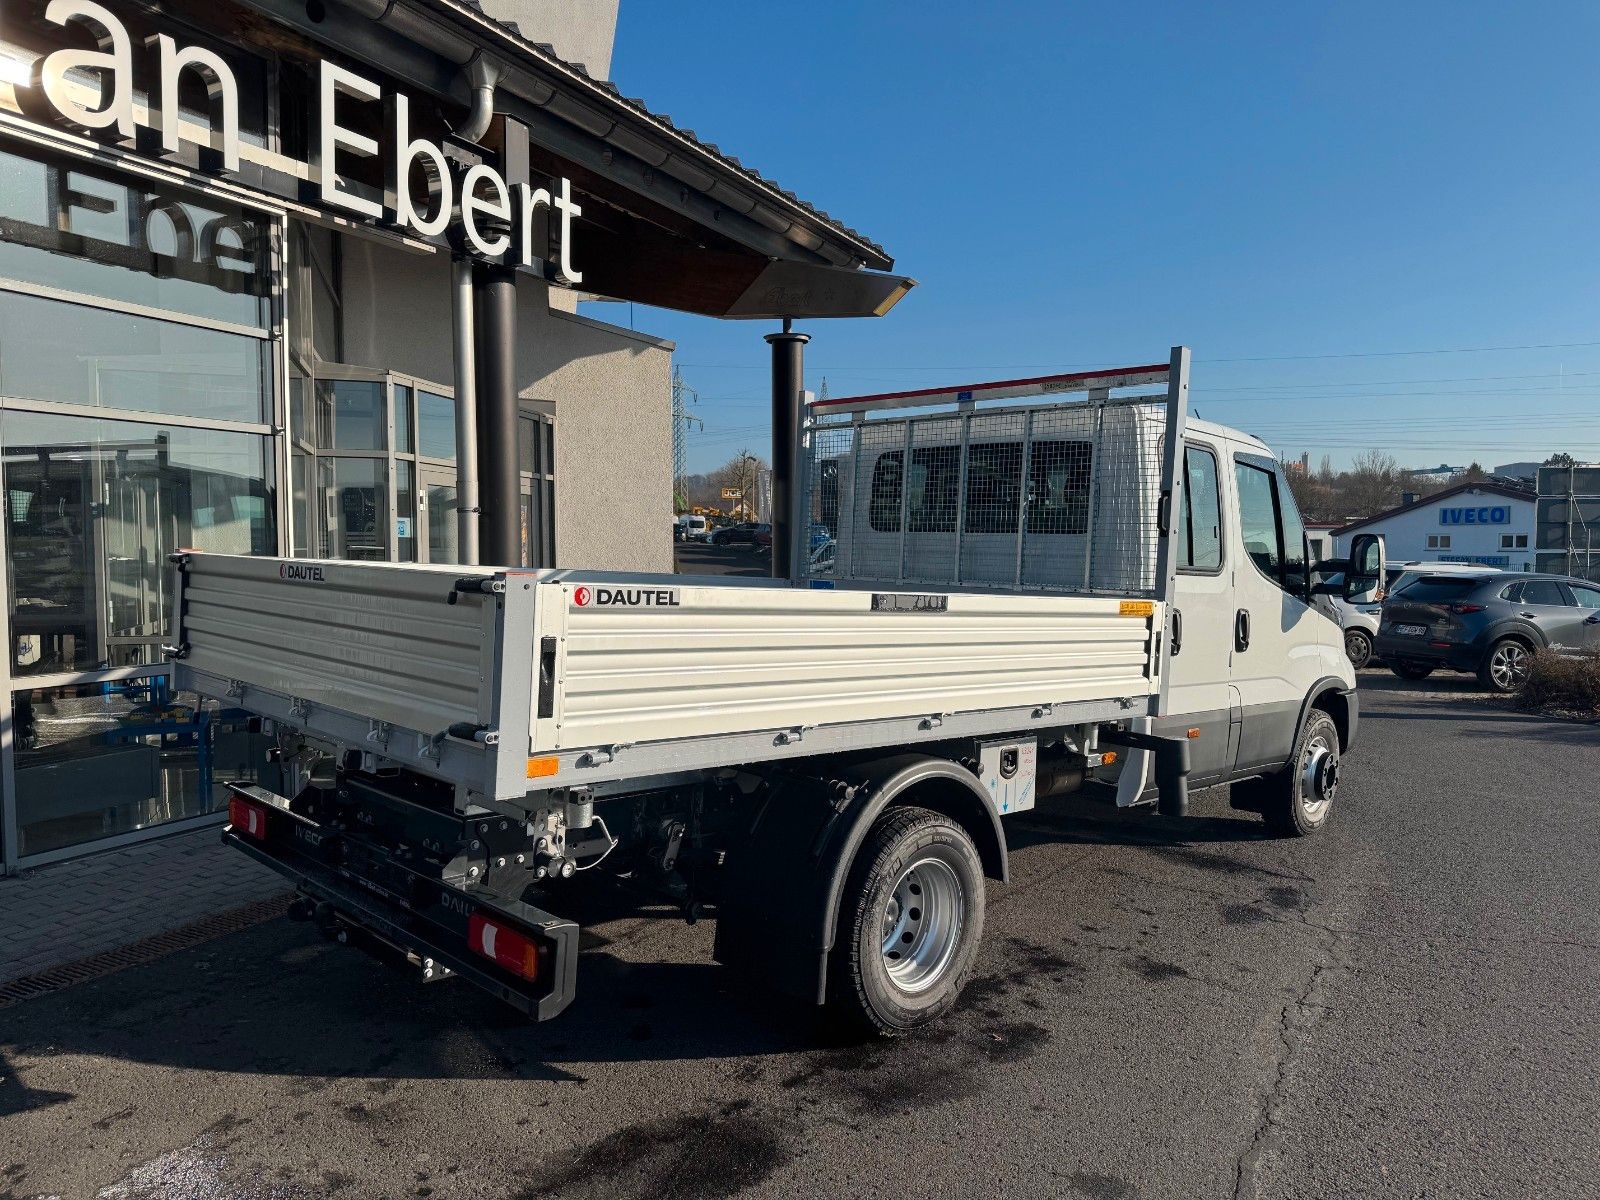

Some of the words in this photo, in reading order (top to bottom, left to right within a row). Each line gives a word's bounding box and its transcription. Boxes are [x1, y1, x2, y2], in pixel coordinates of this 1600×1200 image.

[319, 59, 583, 284] Ebert
[1441, 507, 1505, 524] IVECO
[287, 565, 325, 582] DAUTEL
[595, 588, 681, 606] DAUTEL
